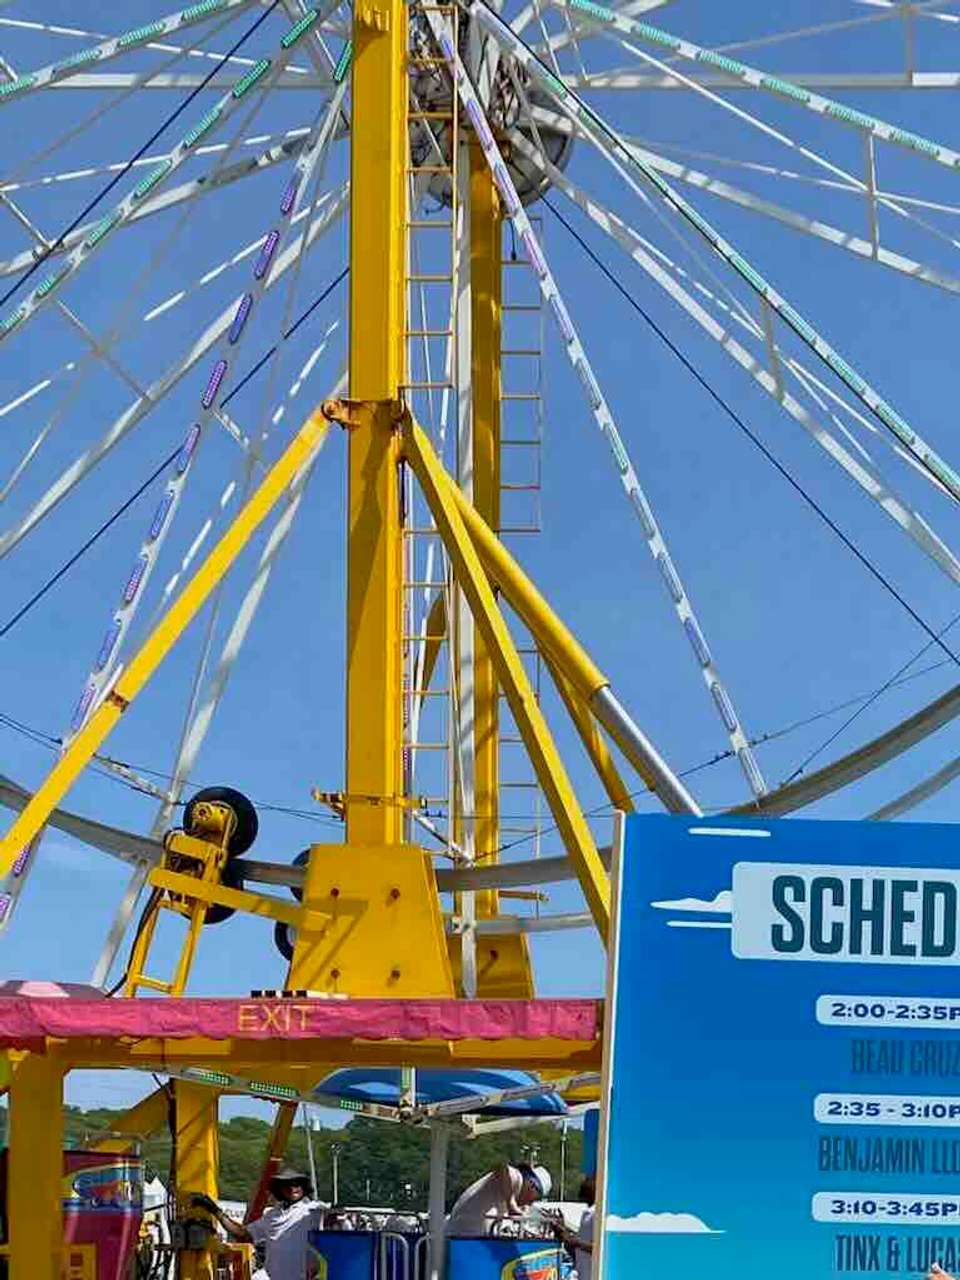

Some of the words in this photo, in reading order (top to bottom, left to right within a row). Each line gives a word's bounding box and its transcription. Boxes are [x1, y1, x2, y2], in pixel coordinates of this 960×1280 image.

[239, 1004, 316, 1032] EXIT
[850, 1039, 905, 1077] BEAU
[910, 1040, 960, 1077] CRUZ
[827, 1100, 881, 1119] 2:35
[819, 1137, 925, 1174] BENJAMIN
[835, 1235, 880, 1271] TINX
[886, 1236, 901, 1271] &
